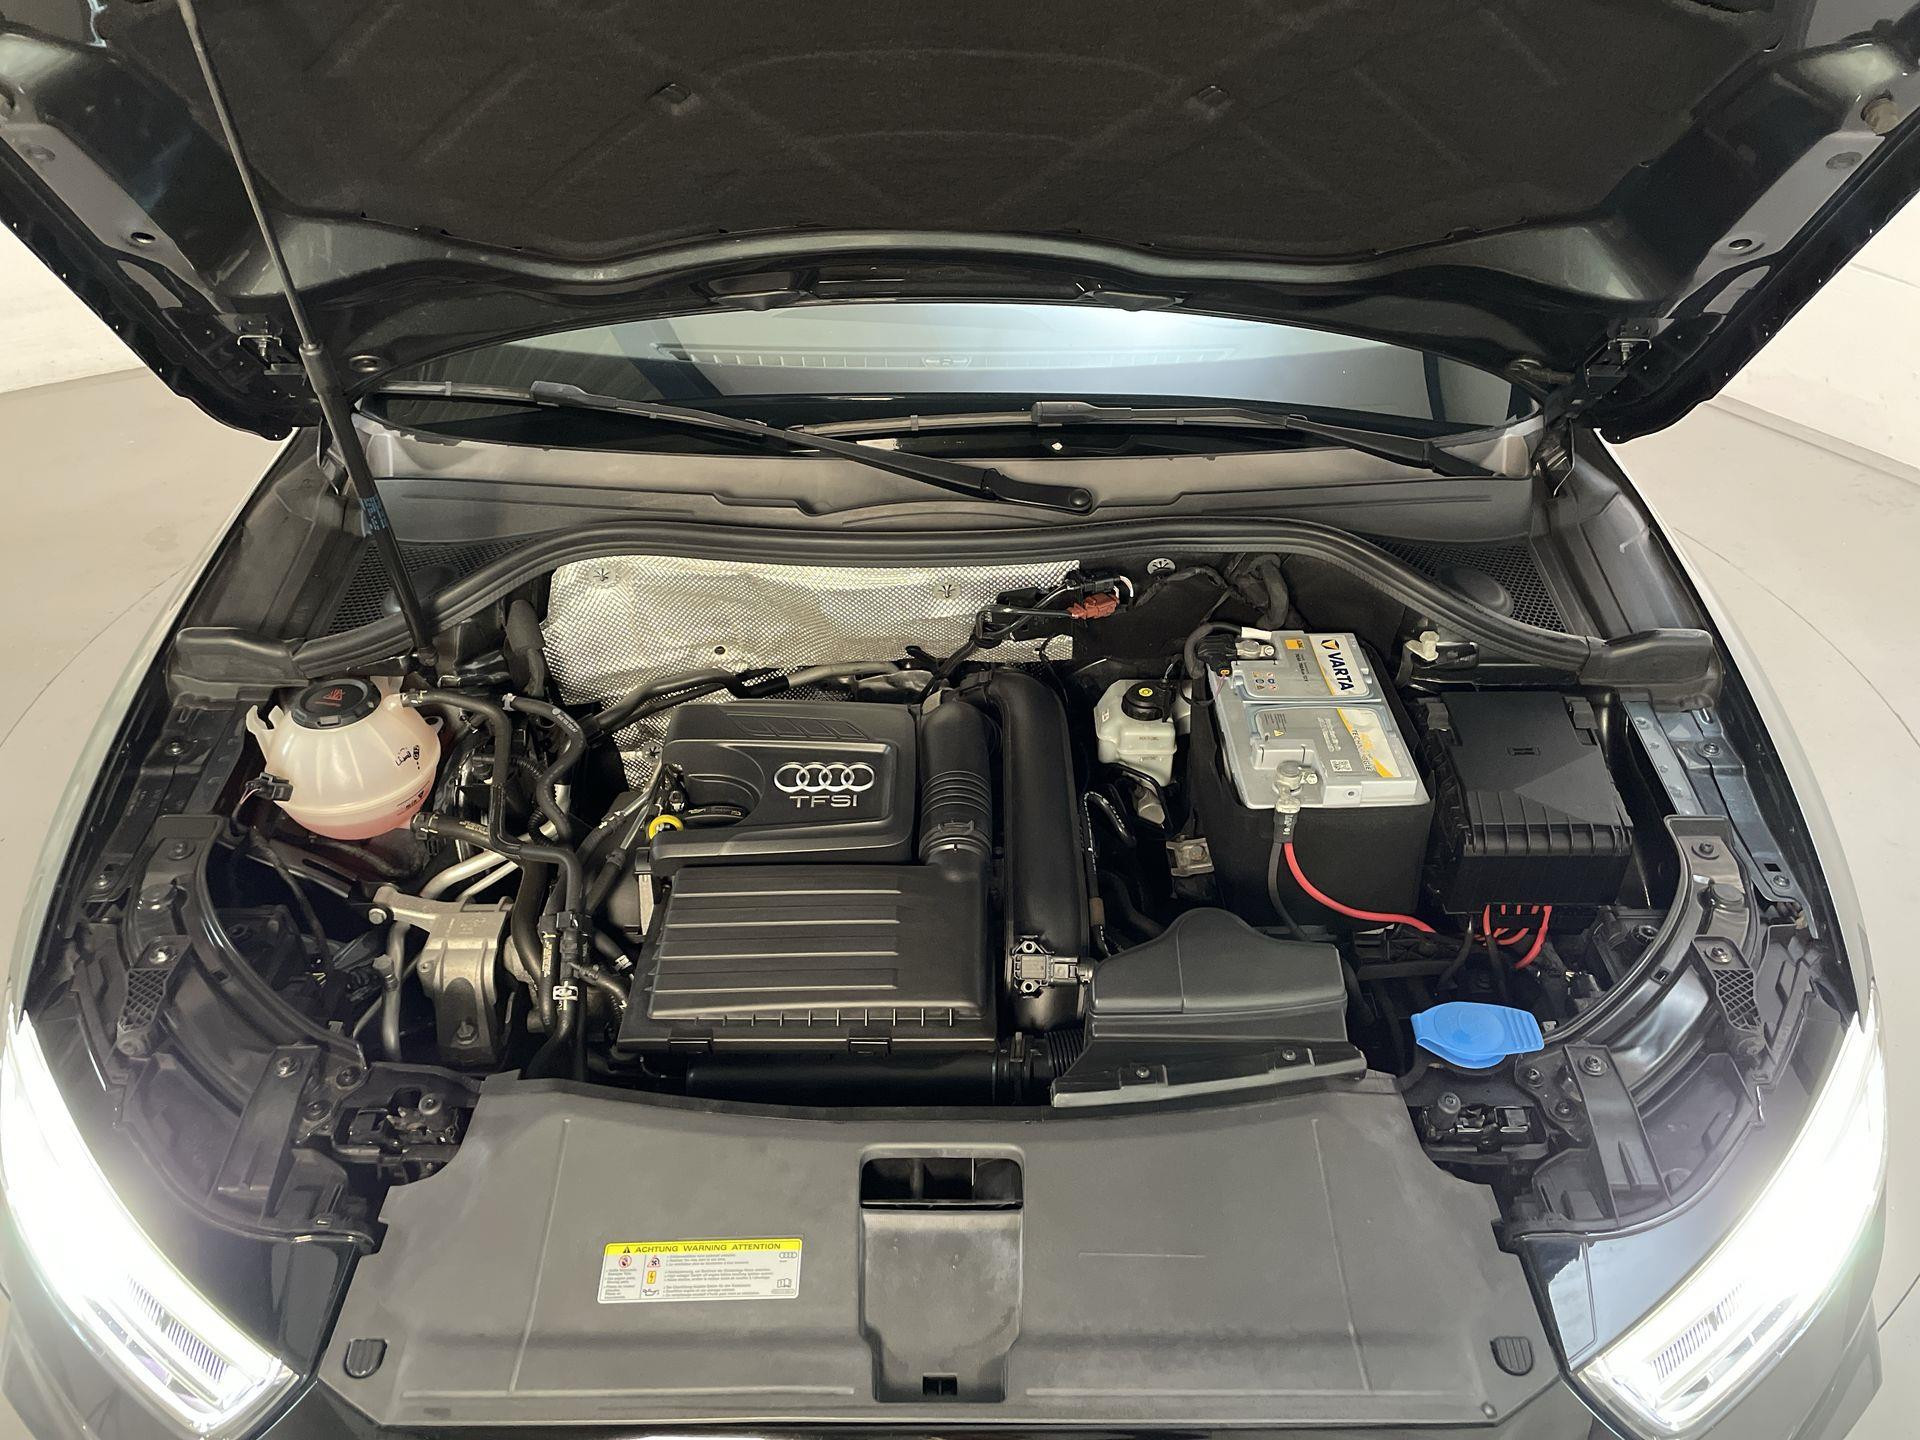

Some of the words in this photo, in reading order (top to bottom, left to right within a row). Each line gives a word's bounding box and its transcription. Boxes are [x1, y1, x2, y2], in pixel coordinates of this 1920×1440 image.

[1327, 651, 1354, 691] VARTA
[1351, 729, 1375, 771] TECHNOGIE
[789, 794, 858, 808] TFSI
[635, 1245, 679, 1253] ACHTUNG
[683, 1244, 727, 1252] WARNING
[731, 1243, 781, 1251] ATTENTION
